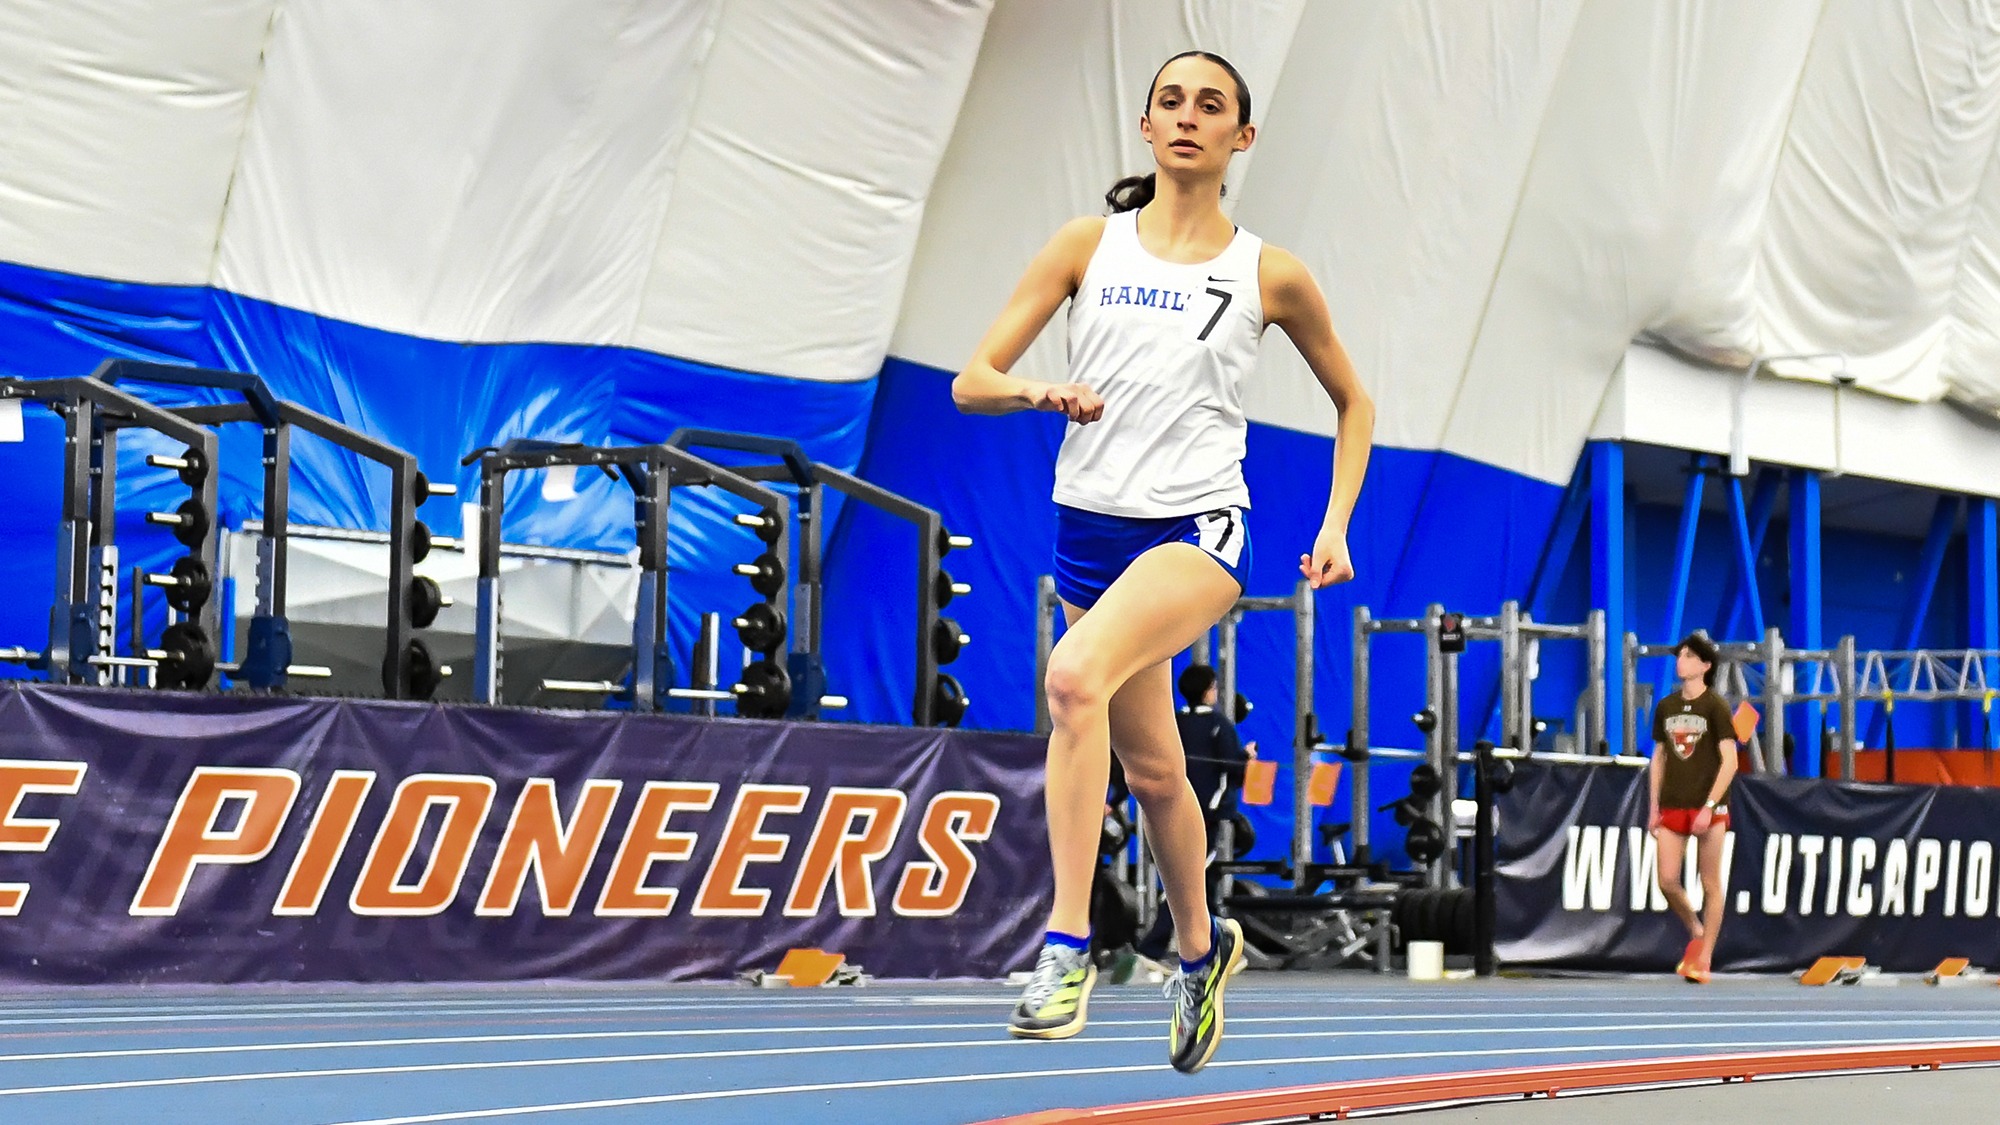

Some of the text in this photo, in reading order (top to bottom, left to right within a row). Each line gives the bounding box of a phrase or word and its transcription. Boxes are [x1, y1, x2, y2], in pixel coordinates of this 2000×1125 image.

[1100, 286, 1191, 312] HAMIL
[1197, 287, 1232, 341] 7
[1206, 510, 1234, 553] 7
[129, 766, 1000, 916] PIONEERS
[1562, 825, 2000, 918] WWW.UTICAPIO
